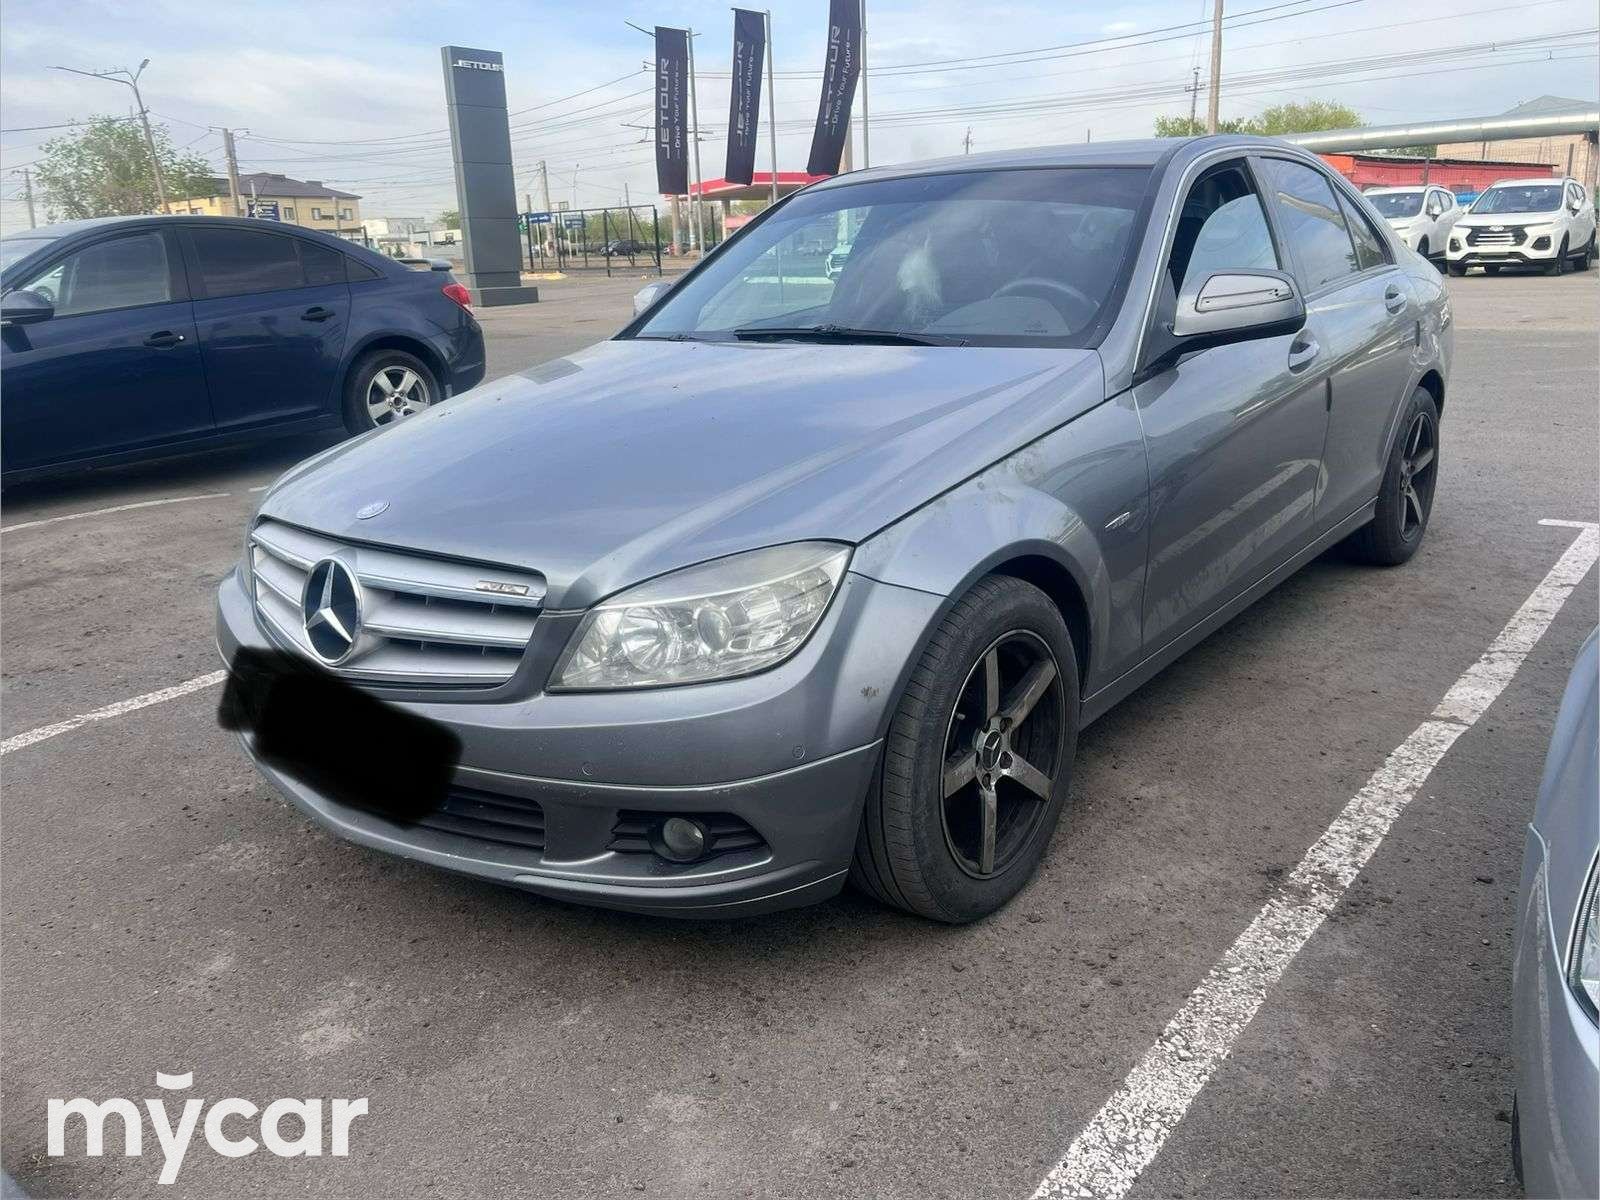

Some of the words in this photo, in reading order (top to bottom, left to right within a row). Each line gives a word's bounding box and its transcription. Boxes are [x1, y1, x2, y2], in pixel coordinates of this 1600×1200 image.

[452, 60, 504, 72] JETOUR
[831, 99, 841, 124] Drive
[836, 74, 848, 97] Your
[842, 42, 851, 74] Future
[660, 58, 670, 159] JETOUR
